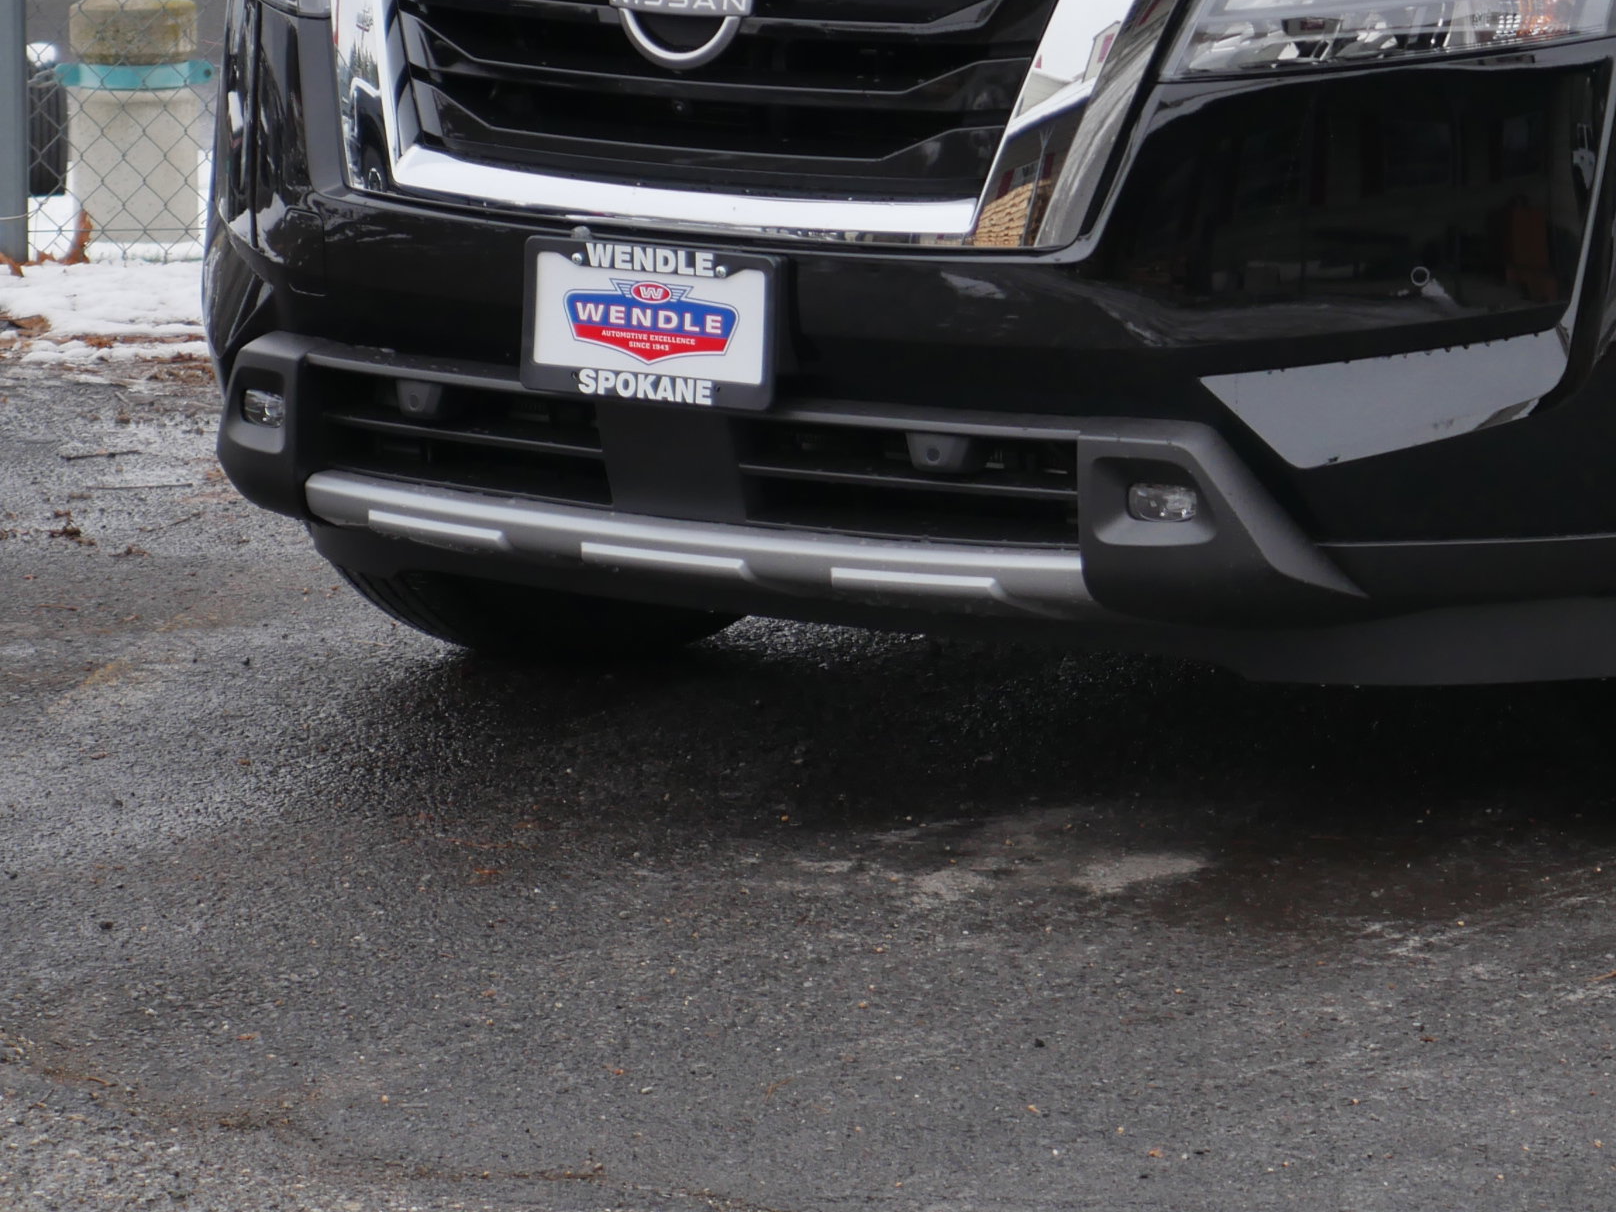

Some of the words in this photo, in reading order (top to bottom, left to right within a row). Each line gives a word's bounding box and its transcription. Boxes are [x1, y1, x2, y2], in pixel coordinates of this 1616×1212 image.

[586, 242, 715, 277] WENDLE
[576, 302, 722, 334] WENDLE
[602, 329, 648, 341] AUTOMOTIVE
[649, 334, 696, 345] EXCELLENCE
[629, 341, 650, 349] SINCE
[578, 368, 713, 405] SPOKANE
